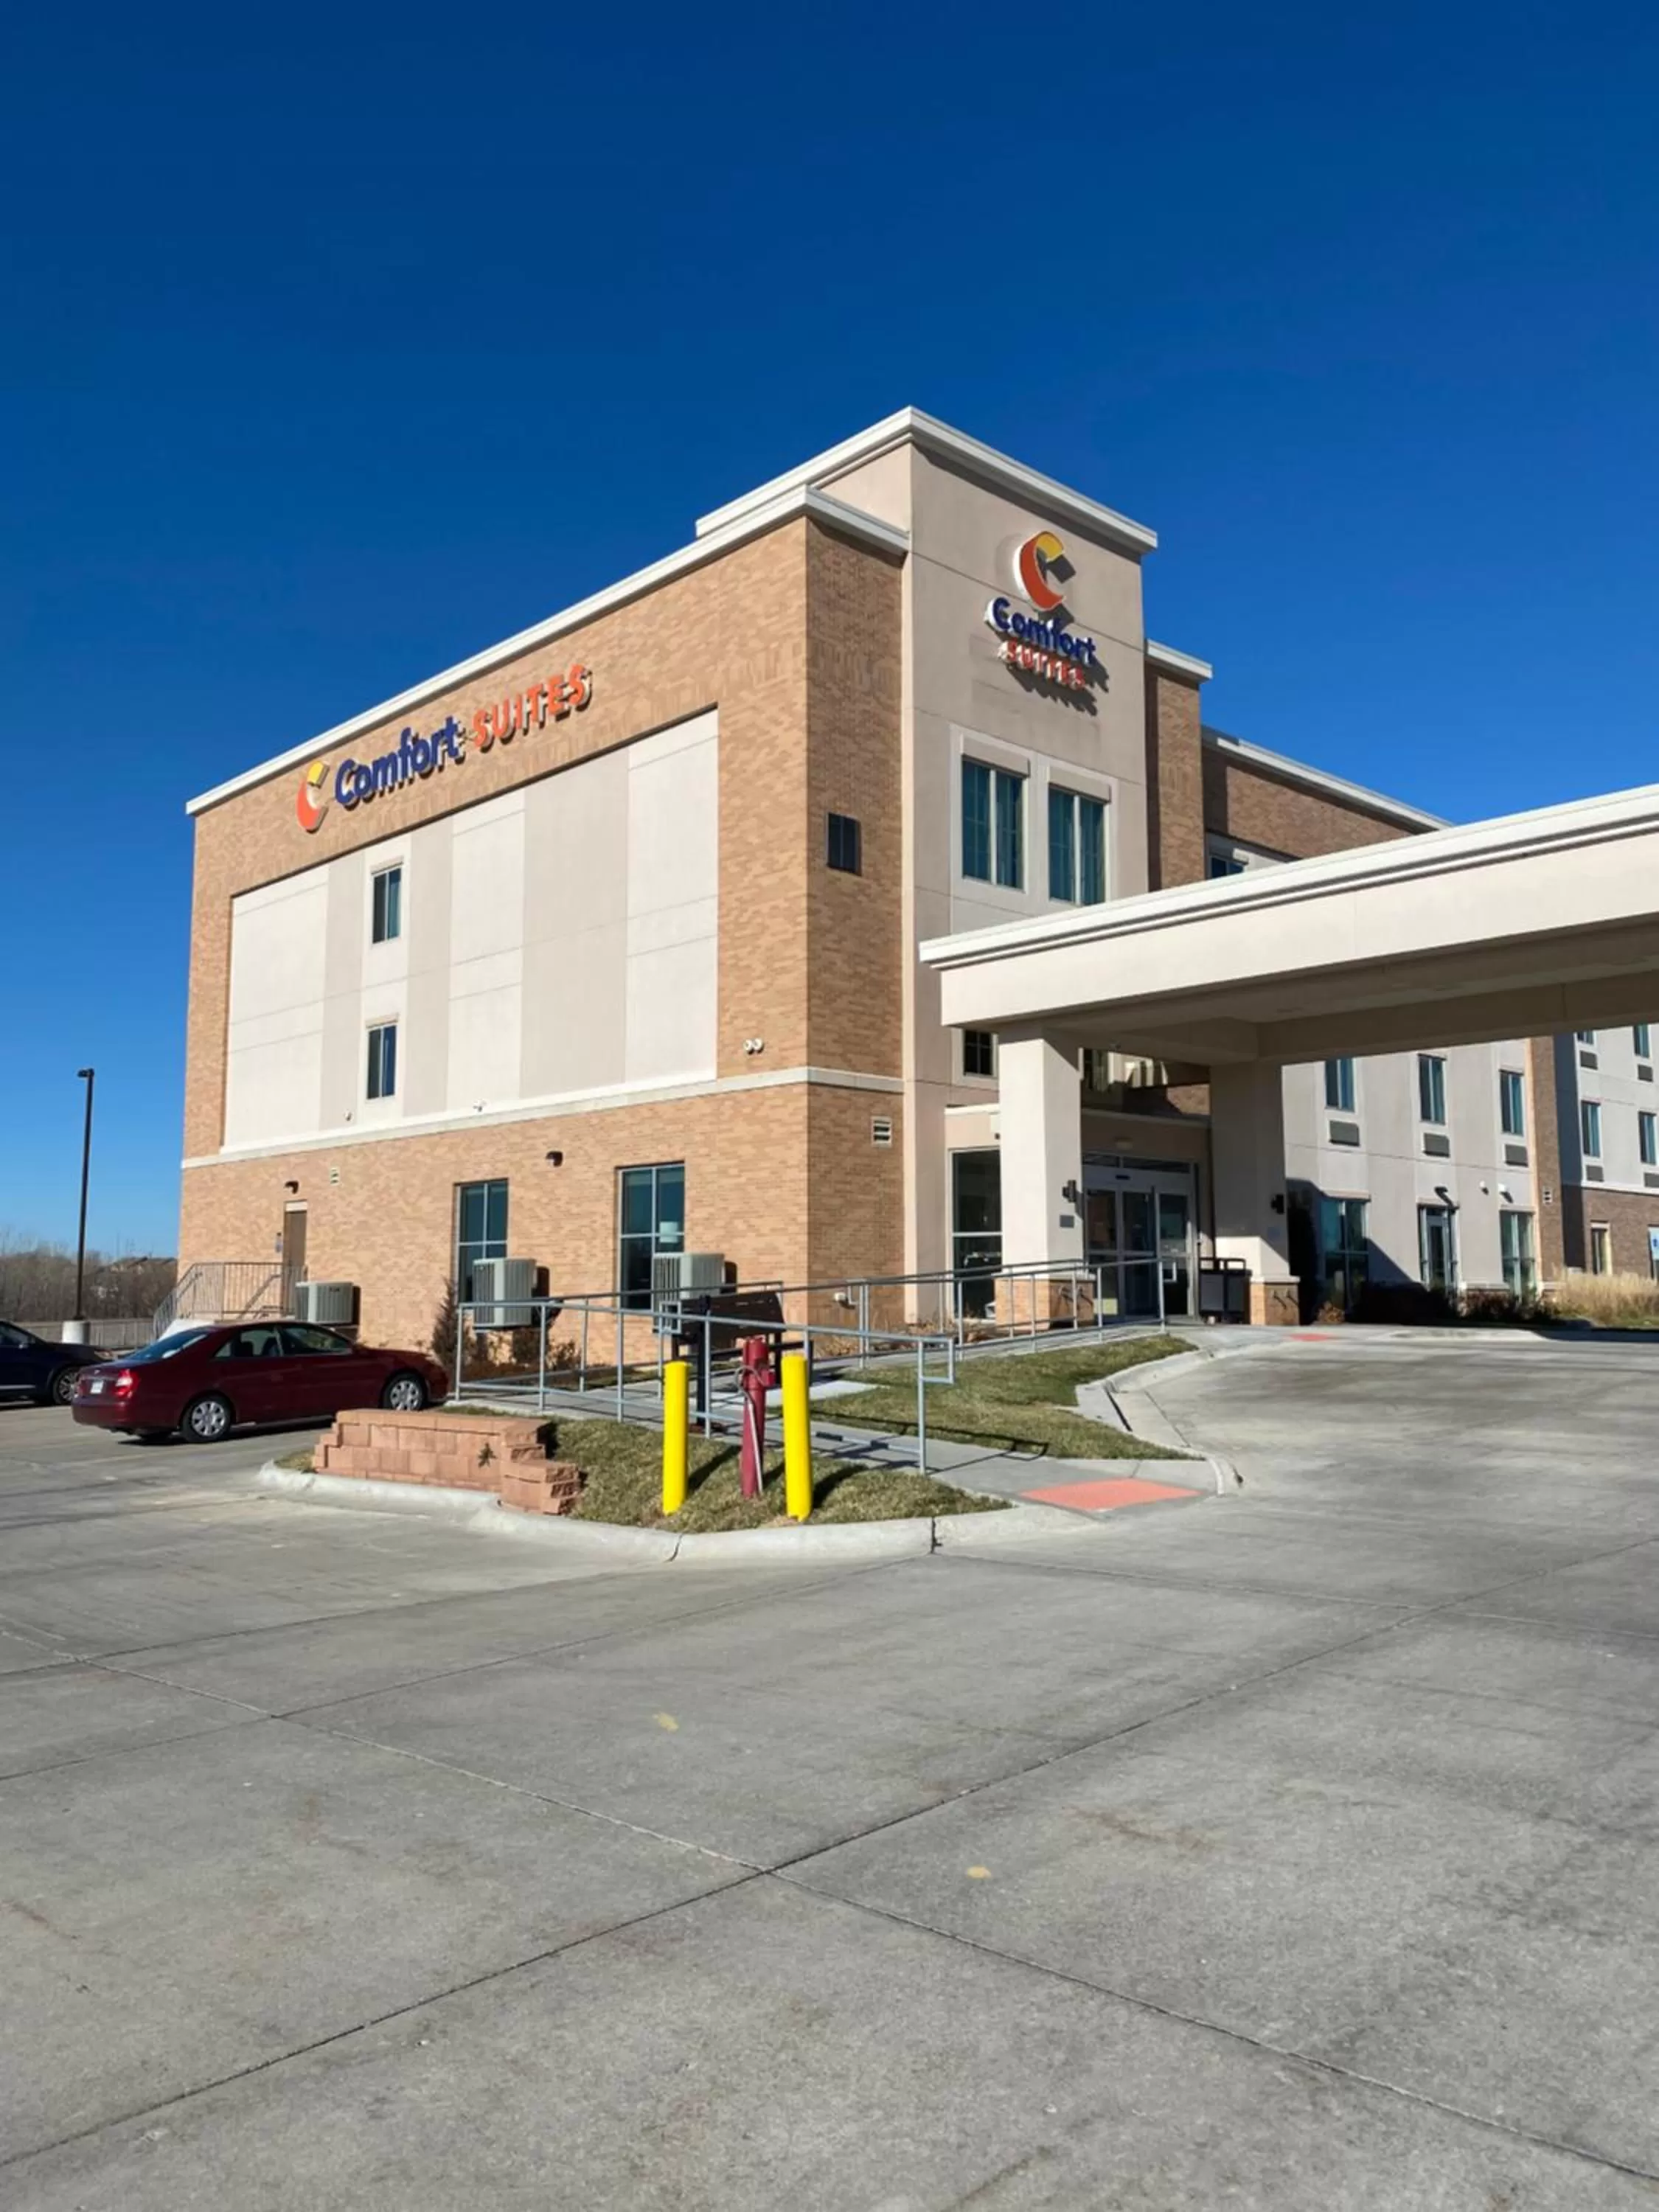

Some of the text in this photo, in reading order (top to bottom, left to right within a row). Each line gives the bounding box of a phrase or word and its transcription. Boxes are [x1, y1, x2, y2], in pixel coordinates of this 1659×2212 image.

[987, 597, 1096, 667] Comfort
[998, 638, 1085, 690] SUITES
[334, 715, 462, 806] Comfort
[470, 664, 591, 749] SUITES
